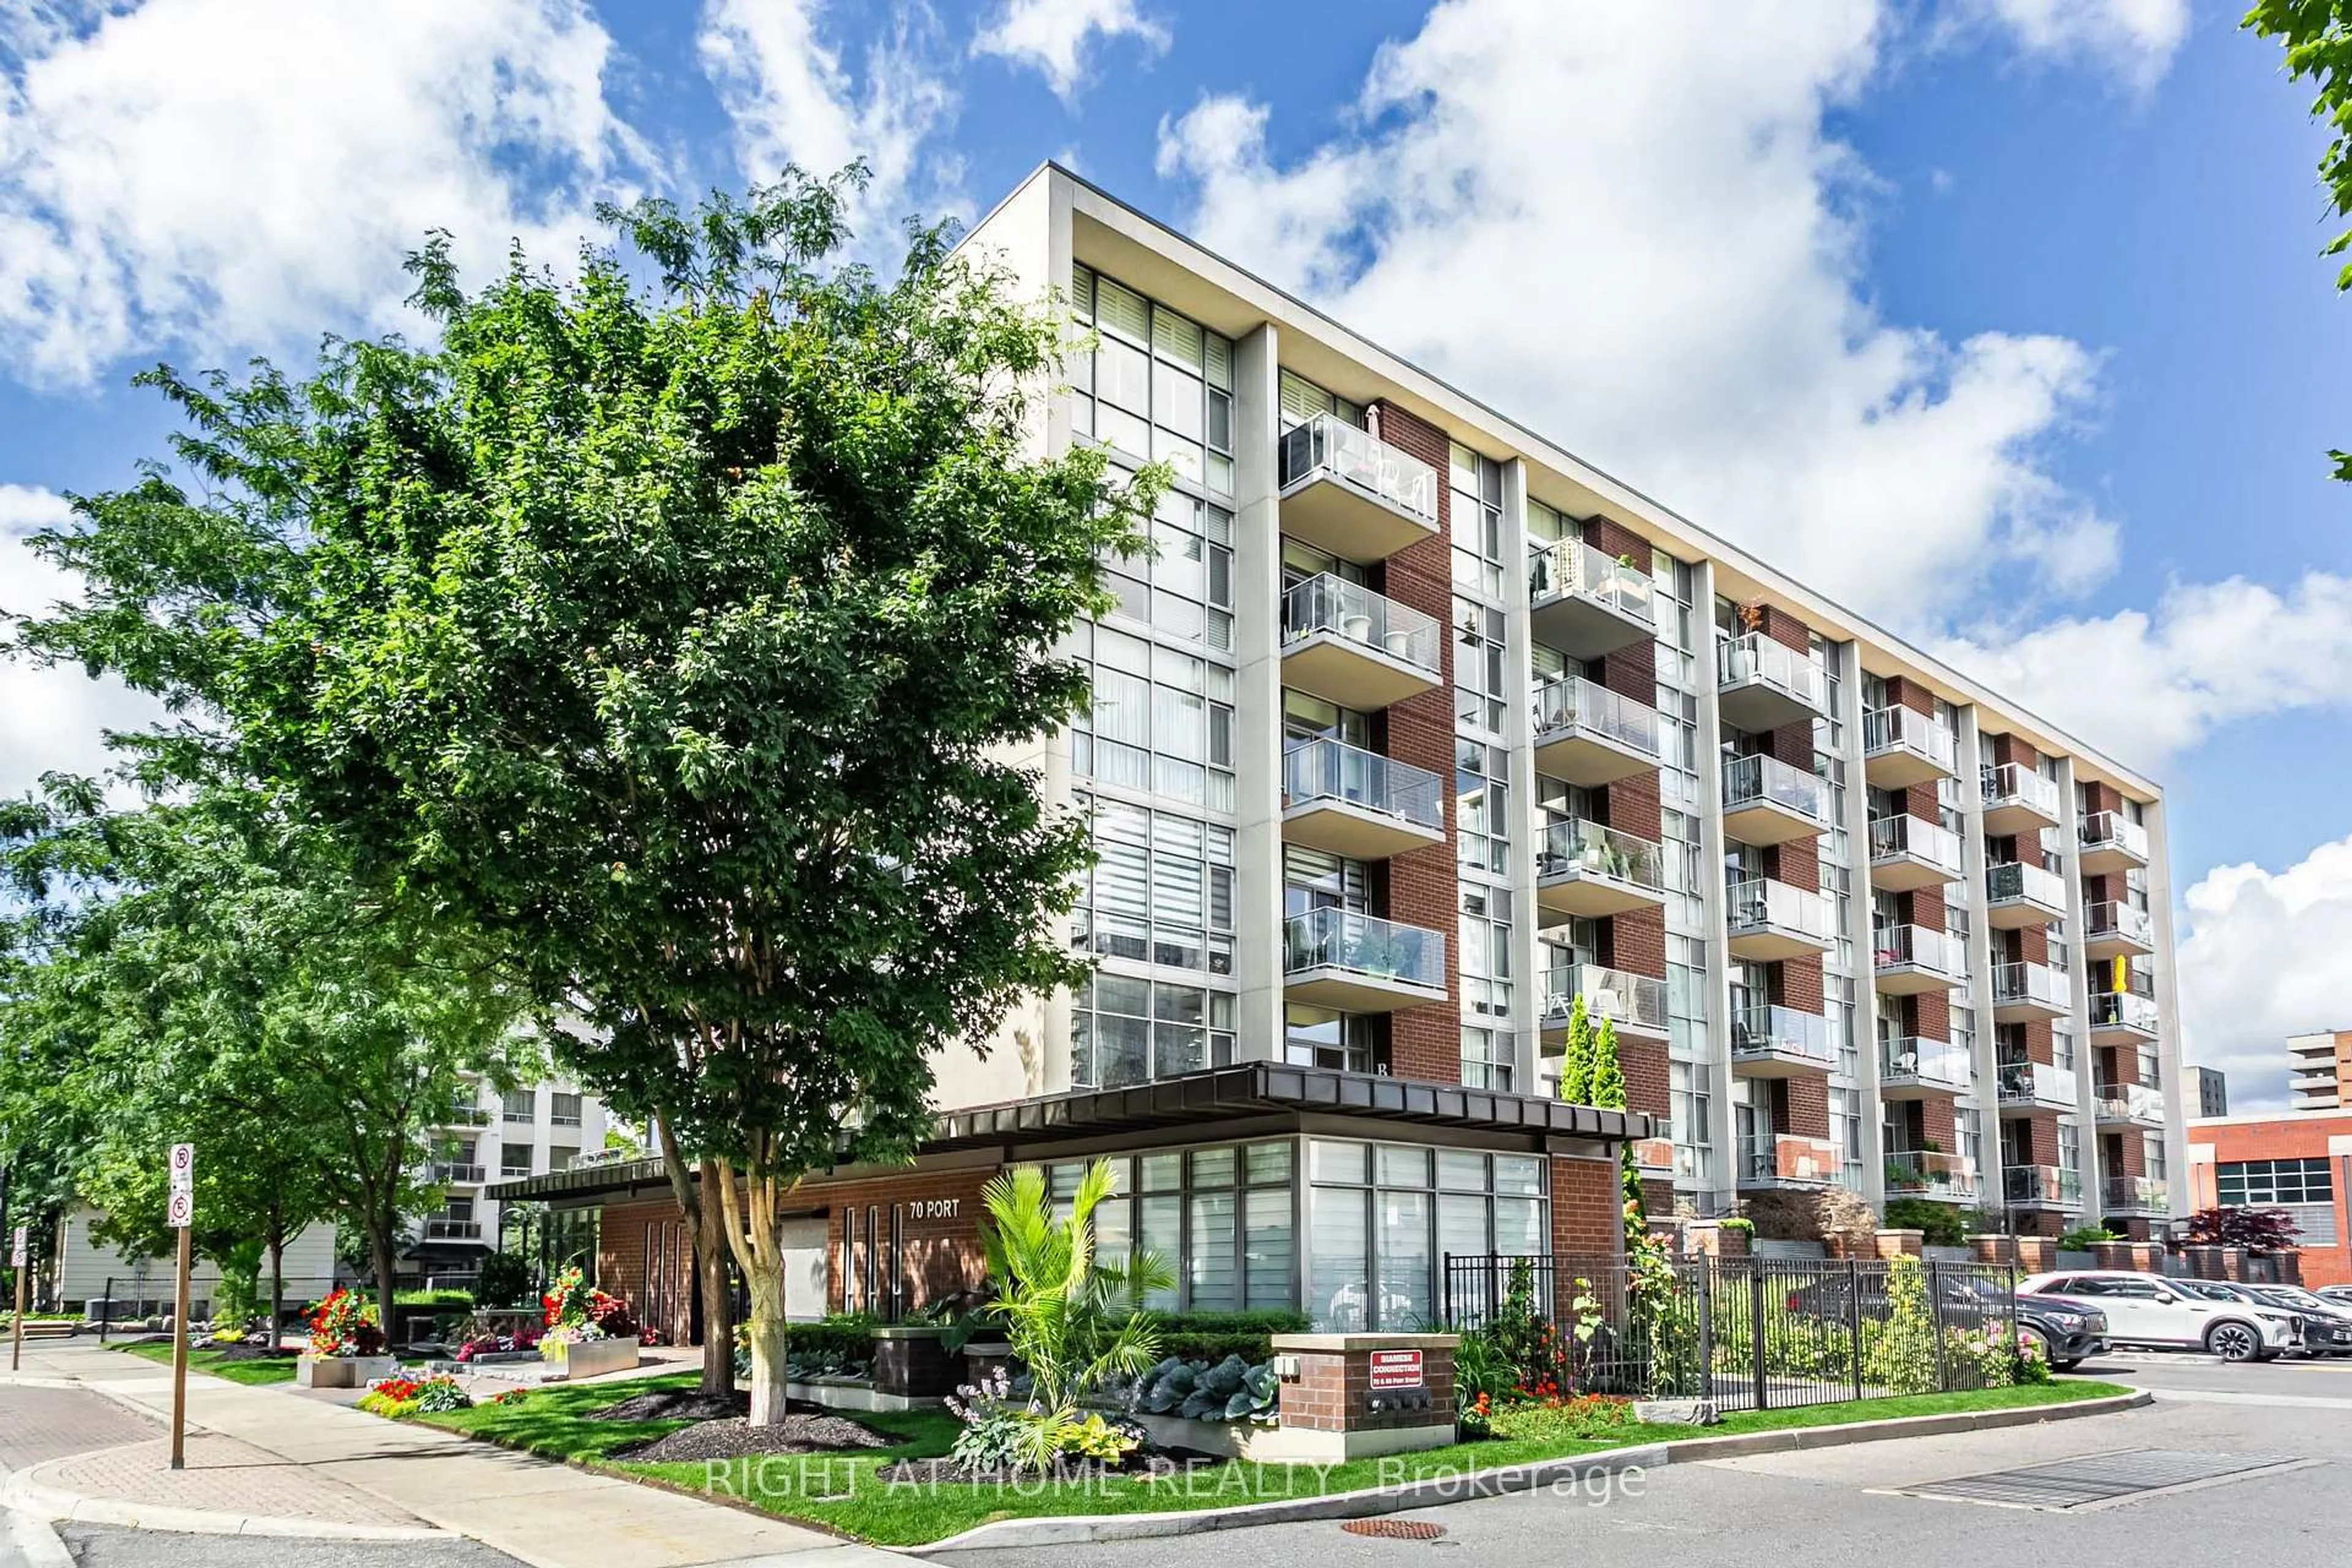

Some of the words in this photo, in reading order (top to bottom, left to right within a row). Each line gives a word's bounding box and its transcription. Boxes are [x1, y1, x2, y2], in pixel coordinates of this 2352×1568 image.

[910, 1201, 924, 1219] 70
[927, 1199, 960, 1218] PORT
[1373, 1364, 1420, 1374] CONNECTION
